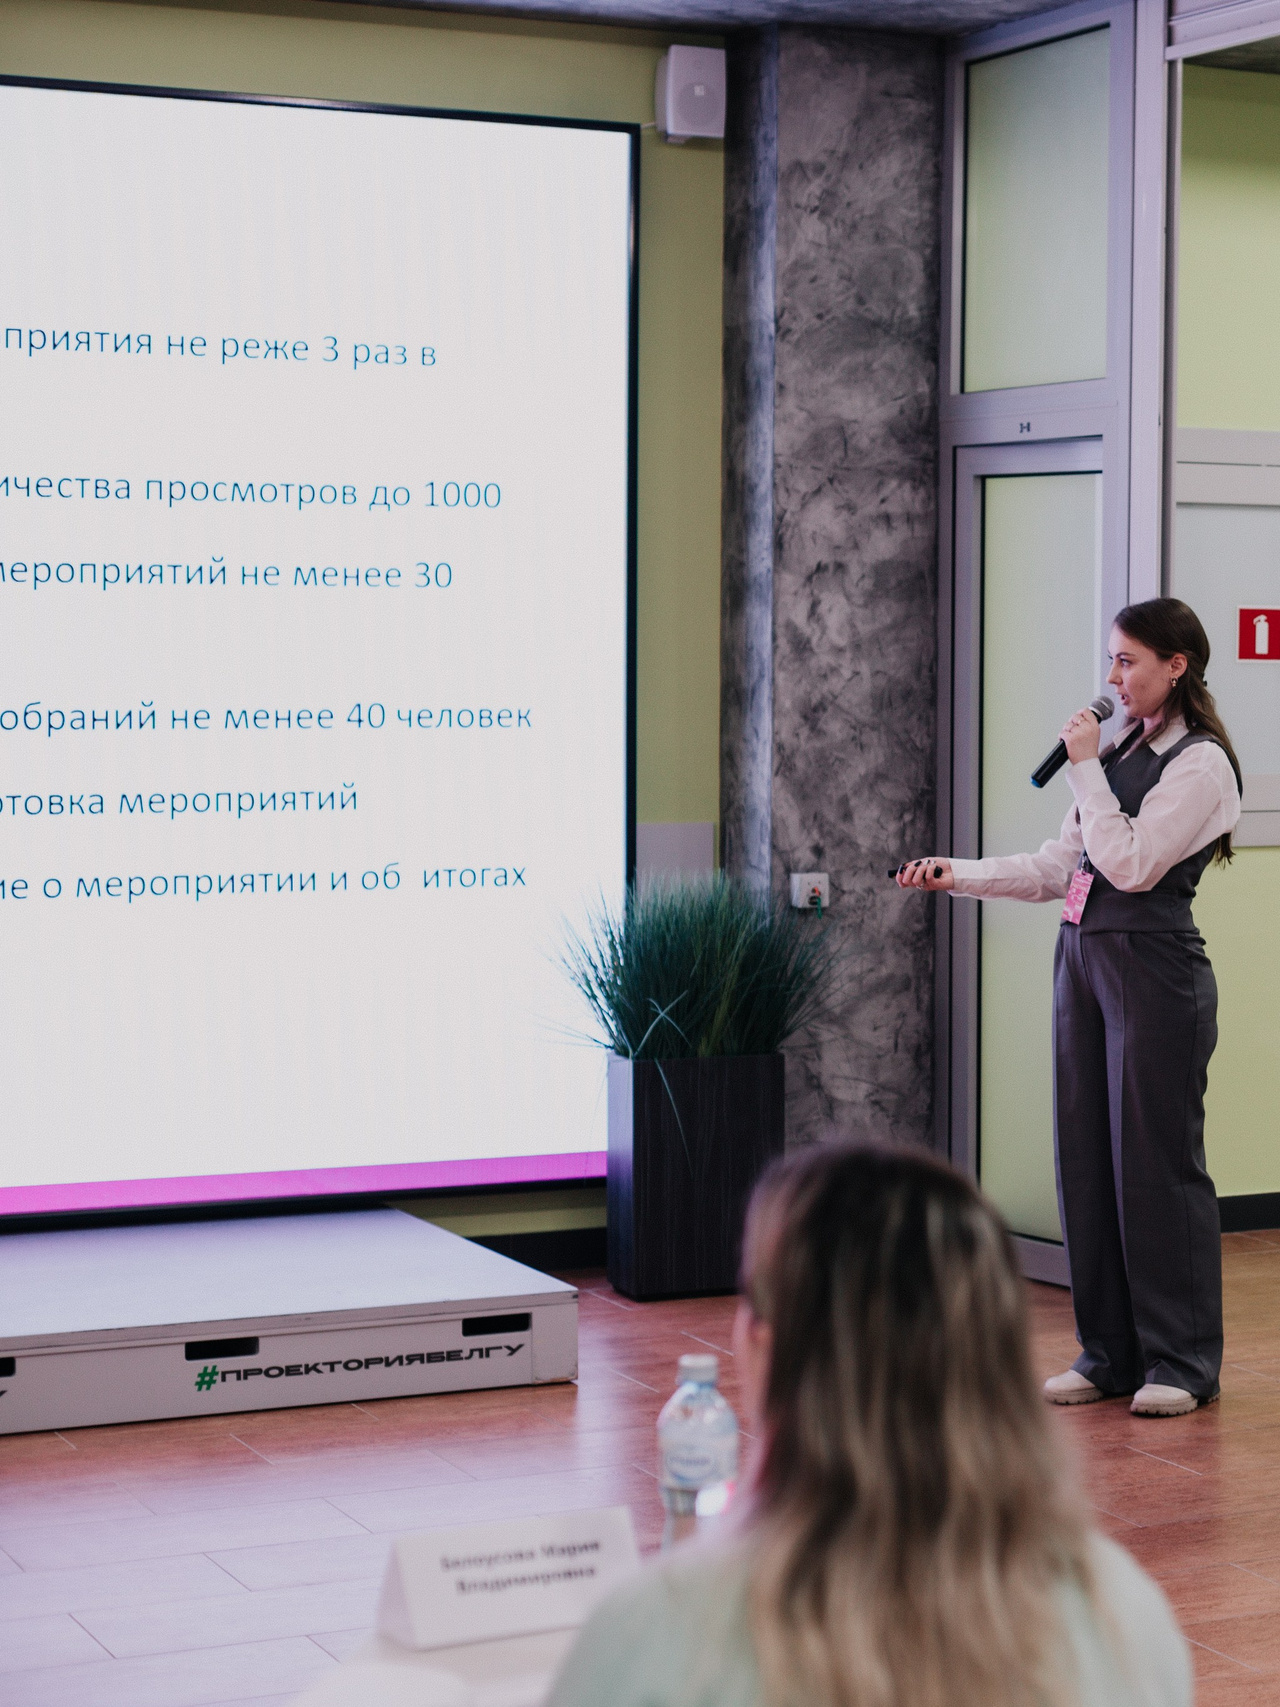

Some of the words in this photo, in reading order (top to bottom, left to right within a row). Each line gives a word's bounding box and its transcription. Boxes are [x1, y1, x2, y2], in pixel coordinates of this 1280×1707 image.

[4, 327, 152, 358] приятия
[167, 334, 207, 357] не
[221, 337, 309, 366] реже
[322, 335, 339, 363] 3
[353, 343, 408, 371] раз
[421, 346, 437, 367] в
[145, 479, 358, 512] просмотров
[368, 485, 411, 512] до
[425, 480, 502, 509] 1000
[0, 555, 227, 592] ероприятий
[241, 565, 281, 587] не
[293, 565, 402, 588] менее
[414, 561, 453, 589] 30
[0, 700, 157, 739] обраний
[170, 709, 211, 730] не
[224, 708, 334, 730] менее
[345, 702, 386, 729] 40
[396, 708, 532, 729] человек
[0, 793, 105, 817] товка
[118, 781, 357, 821] мероприятий
[42, 877, 63, 899] о
[75, 871, 316, 905] мероприятии
[330, 871, 348, 892] и
[361, 861, 401, 891] об
[423, 866, 526, 889] итогах
[194, 1344, 525, 1392] #ПРОЕКТОРИЯБЕЛГУ
